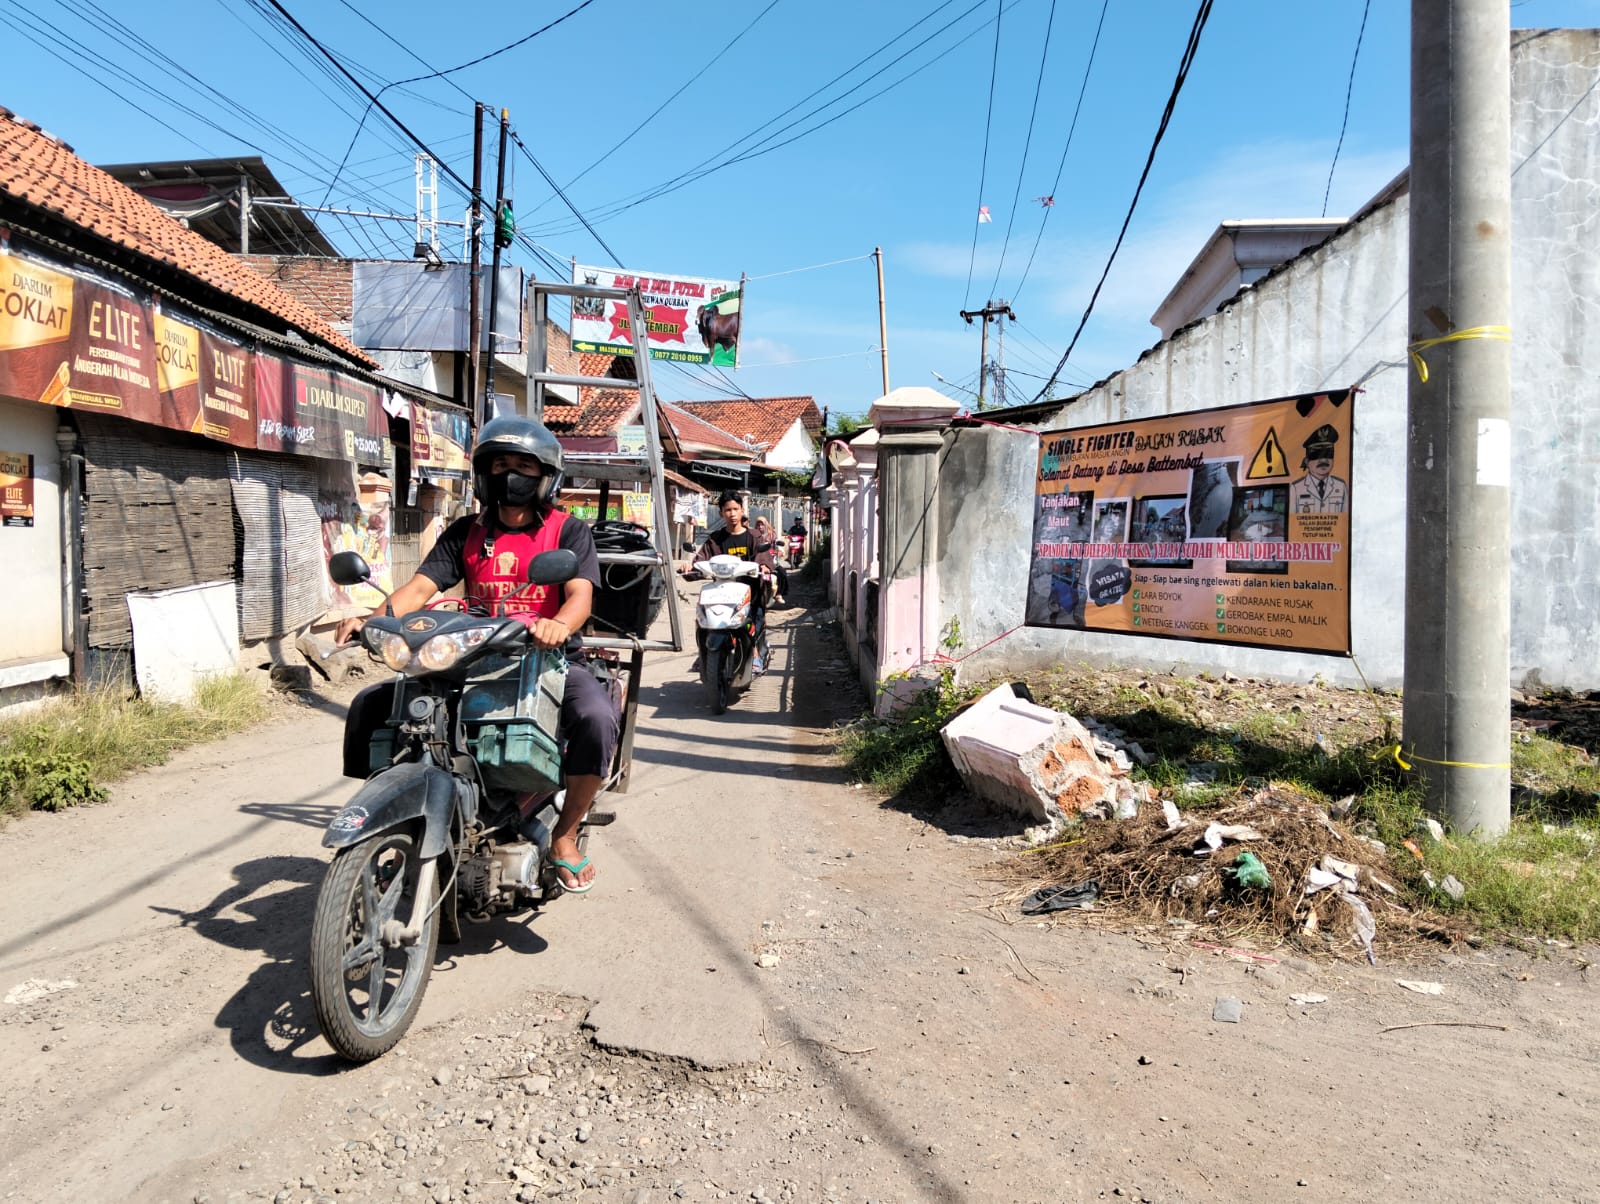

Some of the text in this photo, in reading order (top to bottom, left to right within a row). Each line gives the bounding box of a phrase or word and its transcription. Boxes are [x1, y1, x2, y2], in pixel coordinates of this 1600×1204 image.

[13, 273, 52, 298] DJARUM
[664, 297, 690, 307] QURBAN
[89, 301, 141, 350] ELITE
[164, 329, 188, 347] DJARUM
[73, 354, 113, 377] ANUGERAH
[213, 349, 246, 389] ELITE
[311, 387, 366, 418] DJARUM SUPER
[1048, 438, 1084, 456] SINGLE
[1086, 431, 1135, 450] FIGHTER
[1176, 425, 1226, 448] RUSAK
[1111, 448, 1130, 457] ANGIN
[0, 463, 26, 475] COKLAT
[1038, 452, 1205, 482] Selamat Datang di Desa Battembat
[5, 487, 23, 500] ELITE
[1041, 495, 1080, 510] Tanjakan
[1048, 516, 1070, 528] Maut
[1116, 543, 1151, 558] KETIKA
[1181, 542, 1213, 559] SUDAH
[1216, 542, 1250, 559] MULAI
[1135, 574, 1148, 585] Siap
[1153, 574, 1168, 585] Siap
[1169, 575, 1182, 584] bae
[1184, 576, 1200, 587] sing
[1201, 576, 1241, 588] ngelewati
[1243, 577, 1268, 588] dalan
[1270, 579, 1290, 589] kien
[1141, 591, 1182, 600] LARA BOYOK
[1226, 596, 1313, 609] KENDARAANE RUSAK
[1141, 604, 1164, 614] ENCOK
[1141, 618, 1209, 631] WETENGE KANGGEK
[1226, 610, 1328, 625] GEROBAK EMPAL MALIK
[1227, 624, 1293, 638] BOKONGE LARO
